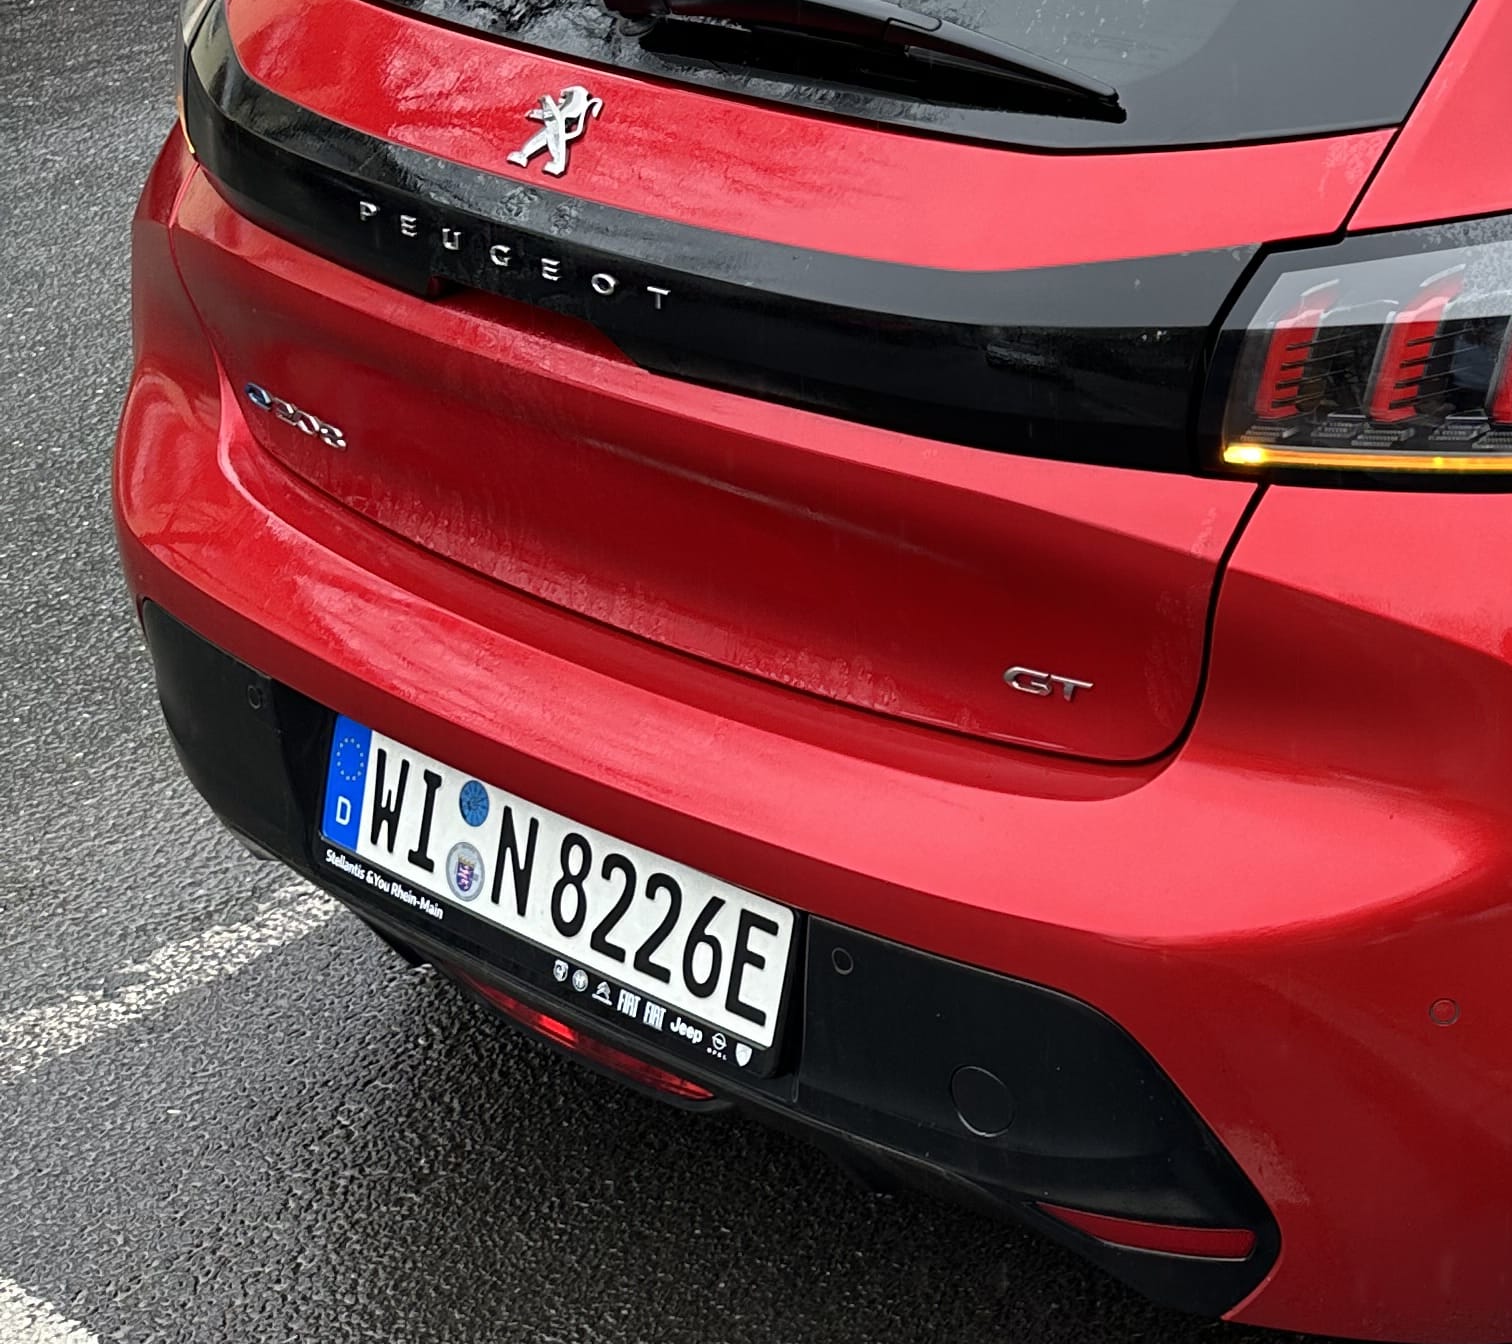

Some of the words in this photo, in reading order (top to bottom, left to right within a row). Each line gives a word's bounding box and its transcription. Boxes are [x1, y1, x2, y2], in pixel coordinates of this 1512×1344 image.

[359, 201, 671, 309] PEUGEOT
[1003, 666, 1094, 702] GT
[325, 849, 365, 880] Stellantis
[390, 881, 444, 920] Rhein-Main
[335, 795, 351, 826] D
[370, 747, 442, 874] WI
[491, 805, 540, 917] N
[551, 832, 780, 1027] 8226E
[617, 988, 642, 1018] FIAT
[670, 1017, 703, 1044] Jeep
